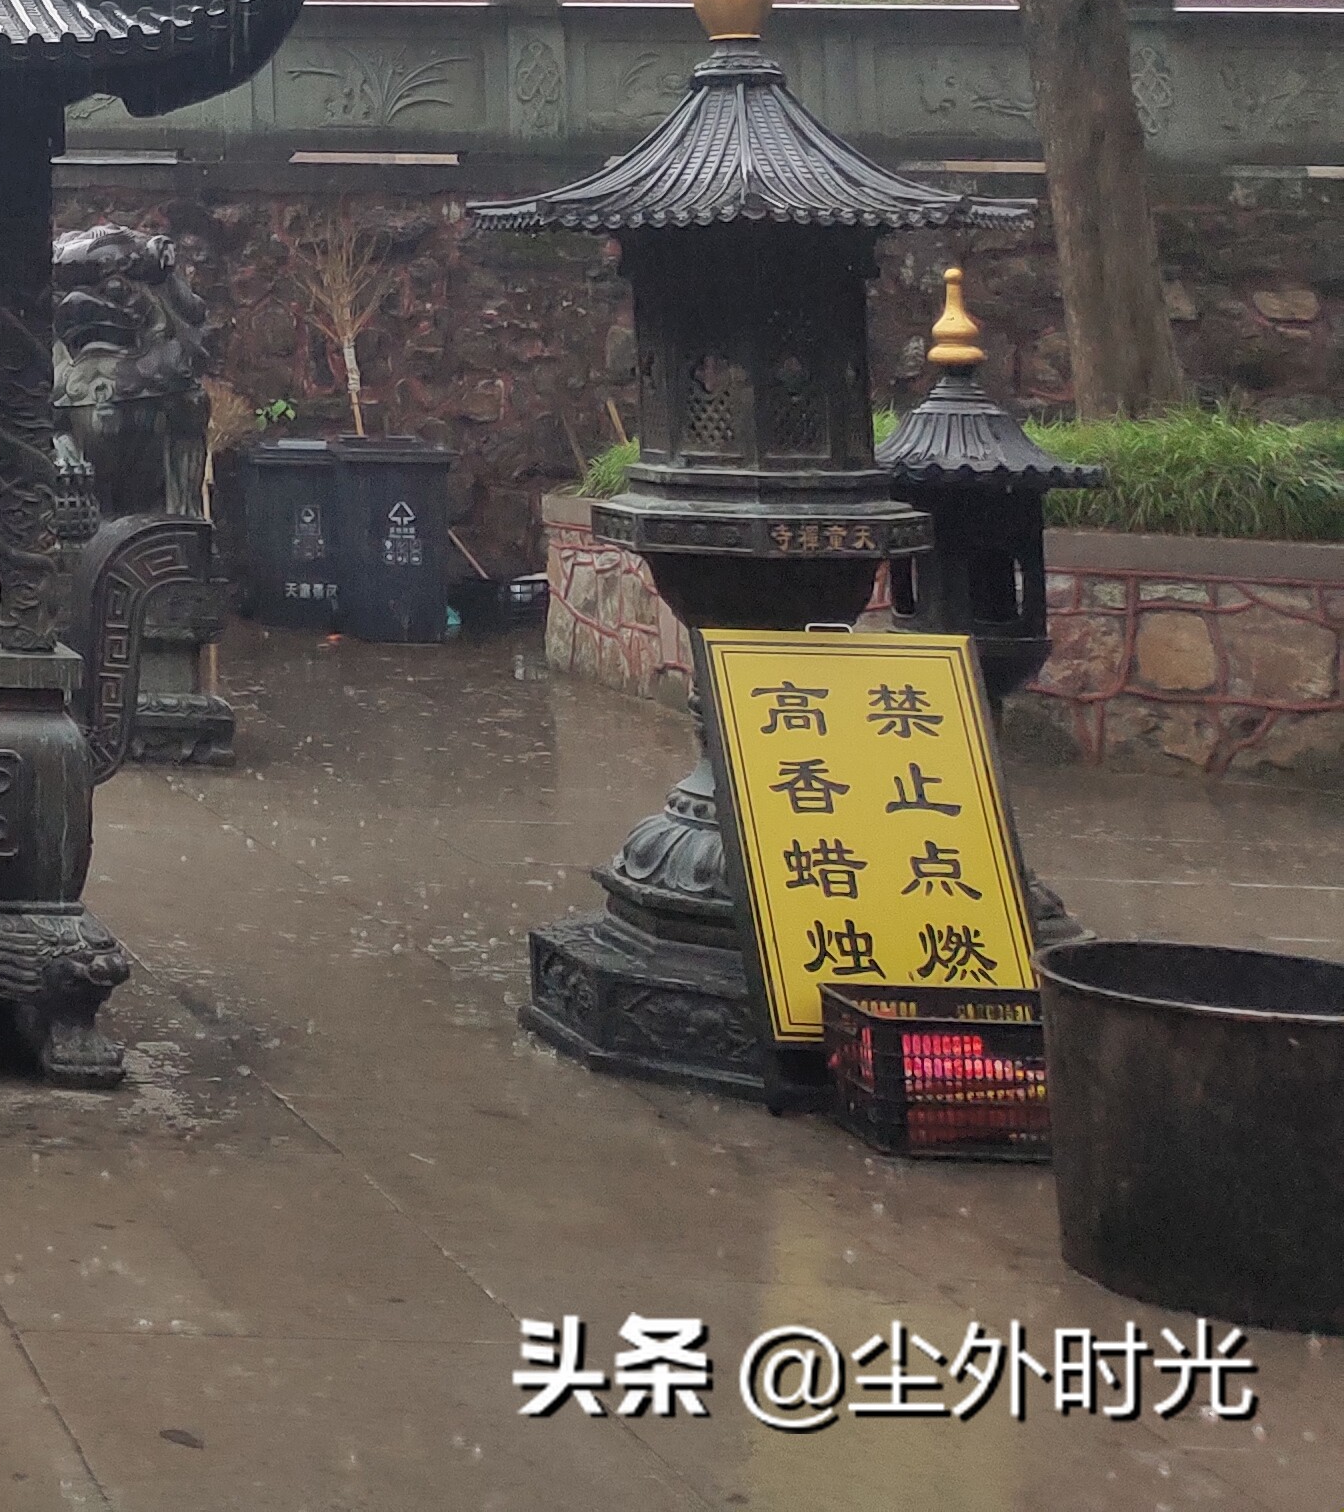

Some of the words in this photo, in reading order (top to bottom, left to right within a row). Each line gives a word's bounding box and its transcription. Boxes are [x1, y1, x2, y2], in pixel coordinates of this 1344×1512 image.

[751, 680, 887, 979] 高香蜡烛
[866, 683, 999, 986] 禁止点燃
